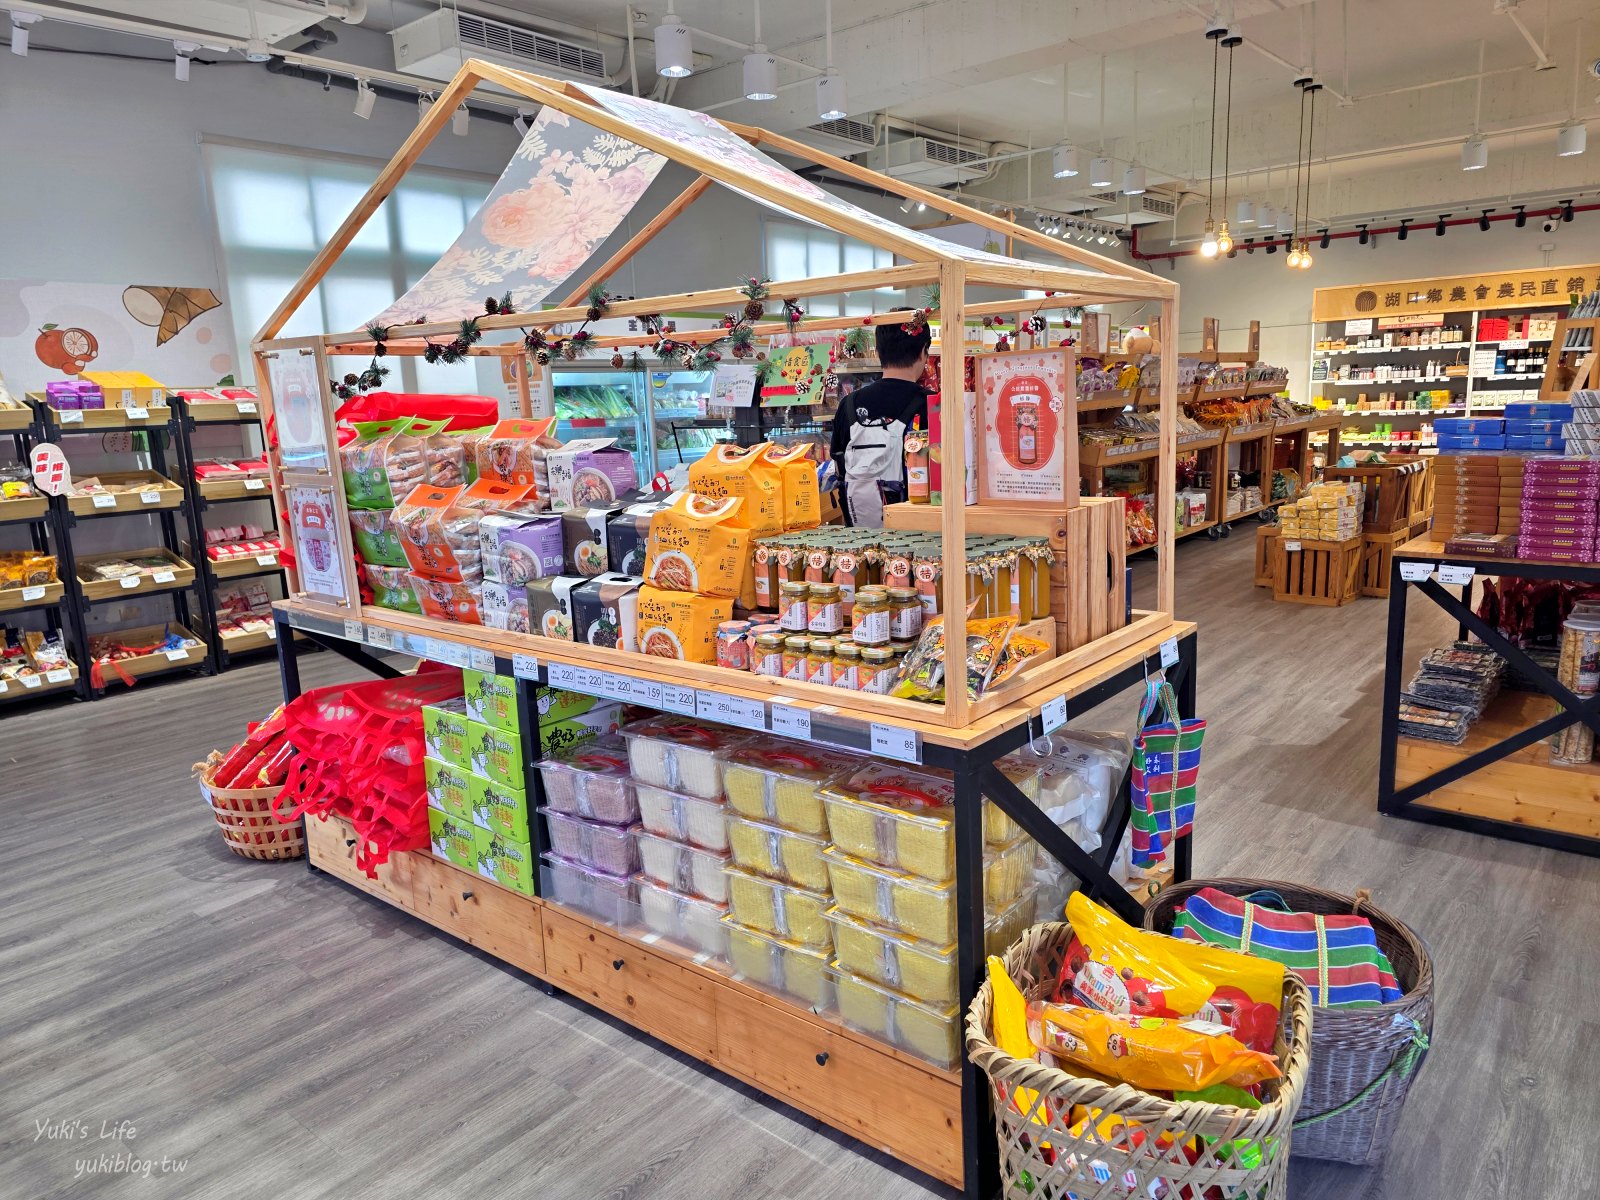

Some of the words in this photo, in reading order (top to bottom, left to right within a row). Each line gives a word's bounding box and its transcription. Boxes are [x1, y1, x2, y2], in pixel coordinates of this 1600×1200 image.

[526, 661, 537, 671] 220
[562, 670, 574, 681] 220
[589, 675, 602, 687] 220
[618, 681, 631, 692] 220
[648, 686, 661, 699] 159
[679, 692, 694, 705] 220
[718, 702, 730, 712] 250
[751, 709, 764, 719] 120
[797, 718, 810, 728] 190
[904, 740, 915, 750] 85
